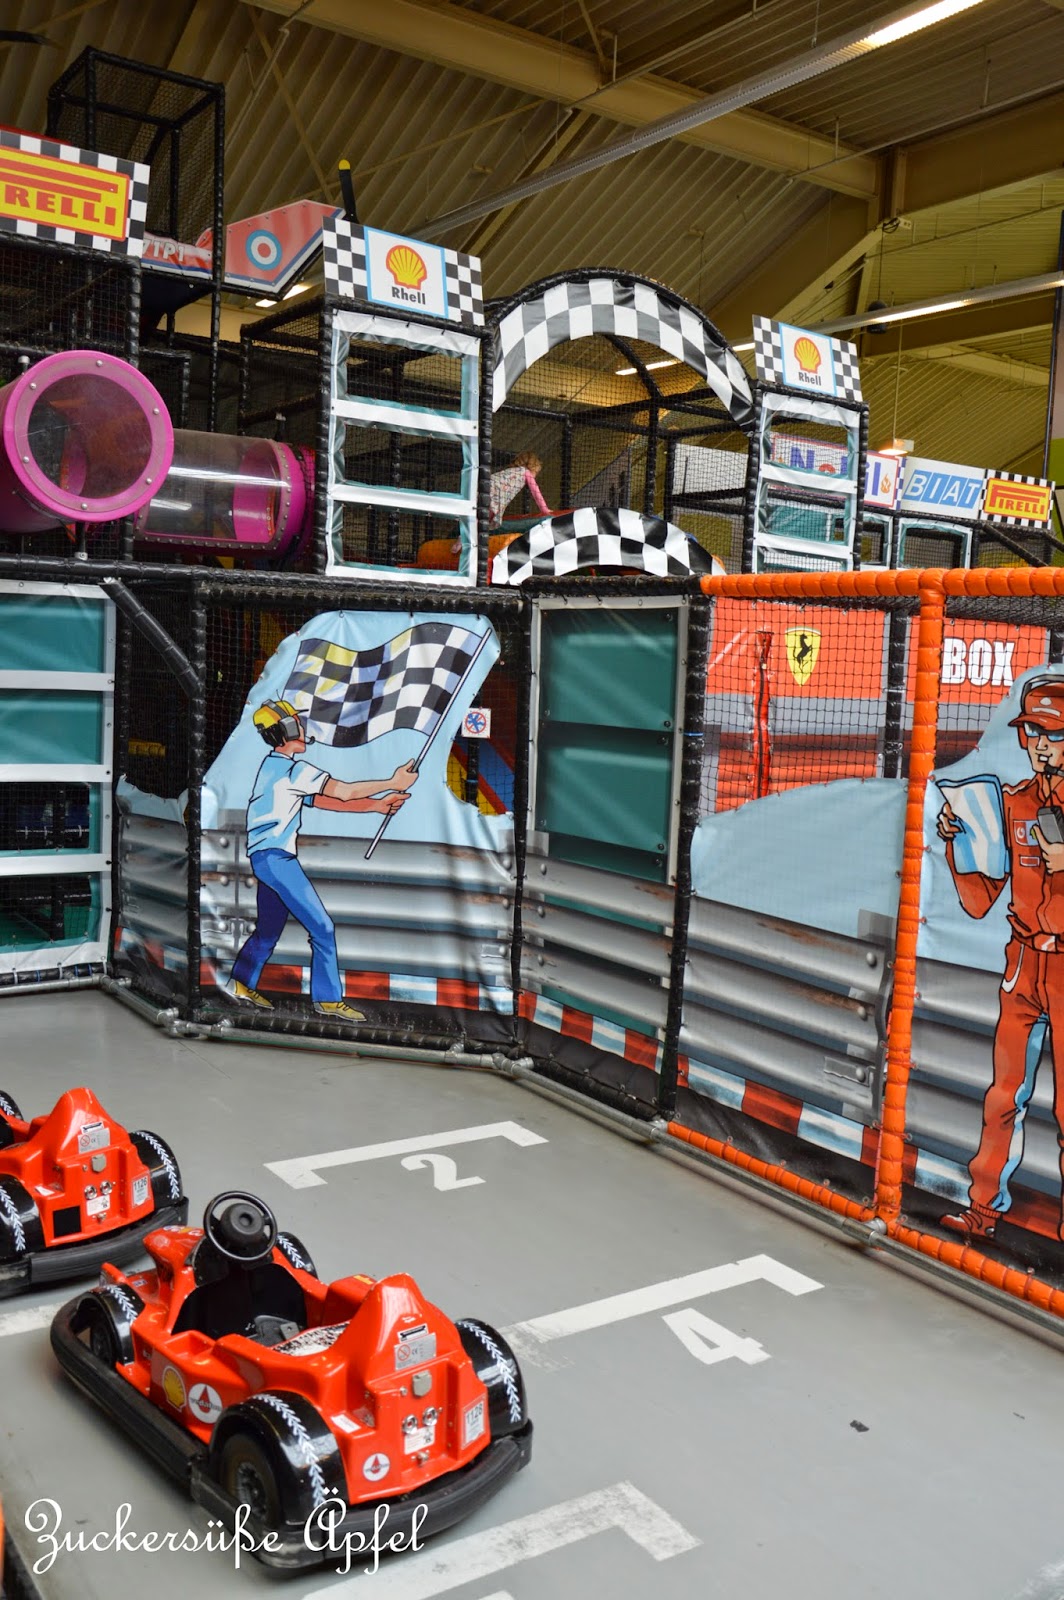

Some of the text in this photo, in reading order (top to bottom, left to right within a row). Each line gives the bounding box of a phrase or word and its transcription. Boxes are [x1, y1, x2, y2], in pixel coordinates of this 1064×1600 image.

[0, 182, 117, 227] RELLI
[391, 286, 426, 305] Rhell
[798, 371, 822, 386] Rhell
[904, 472, 981, 506] BIAT
[988, 484, 1046, 515] PIRELLI
[940, 637, 1016, 688] BOX
[400, 1152, 486, 1192] 2
[661, 1307, 772, 1366] 4
